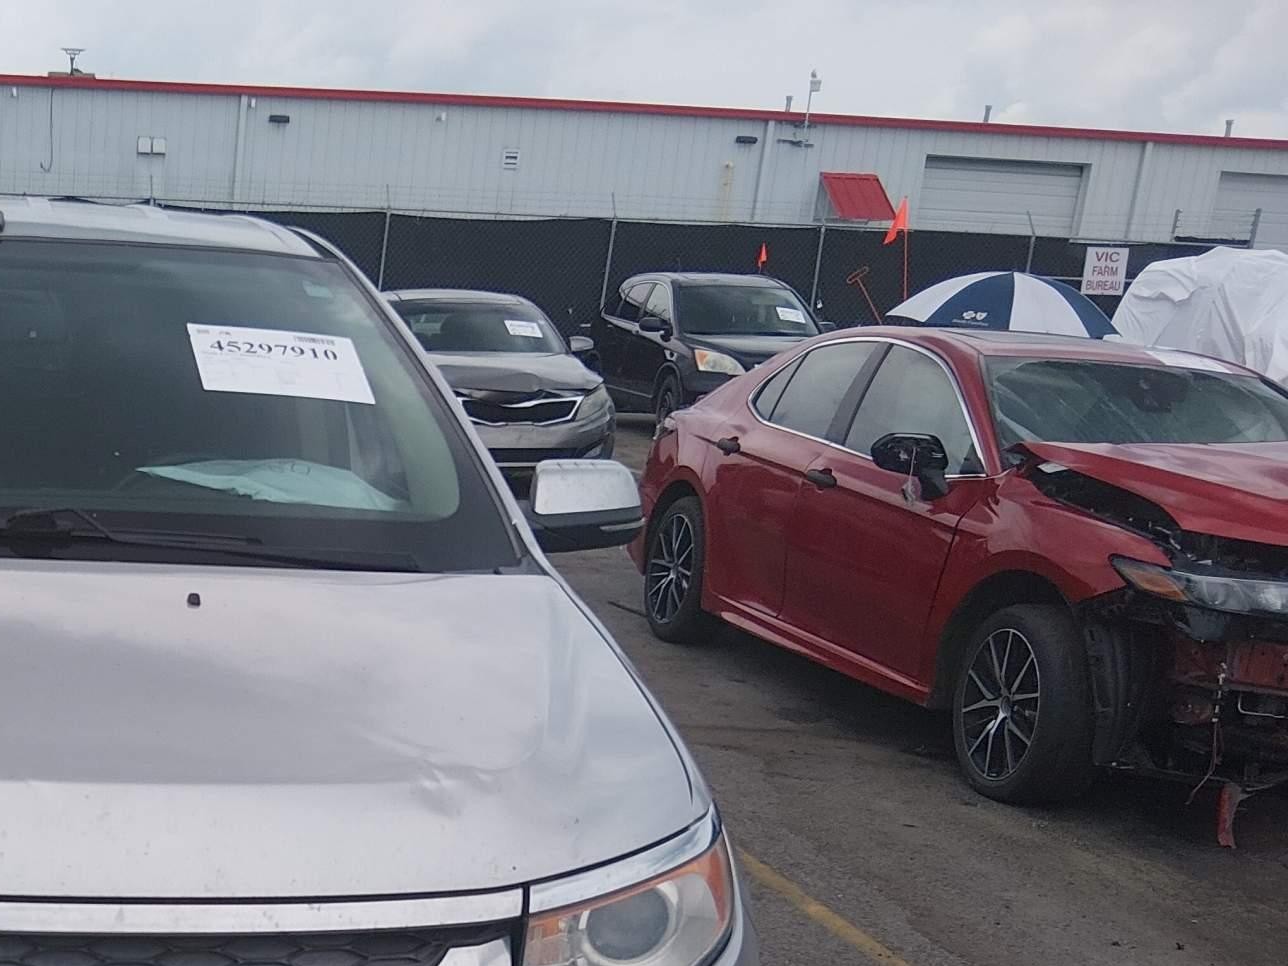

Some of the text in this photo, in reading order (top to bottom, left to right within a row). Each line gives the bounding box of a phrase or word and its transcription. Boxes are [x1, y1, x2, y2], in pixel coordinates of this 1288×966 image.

[1095, 251, 1120, 263] VIC
[1091, 265, 1118, 277] FARM
[1085, 280, 1121, 292] BUREAU
[209, 338, 339, 362] 45297910
